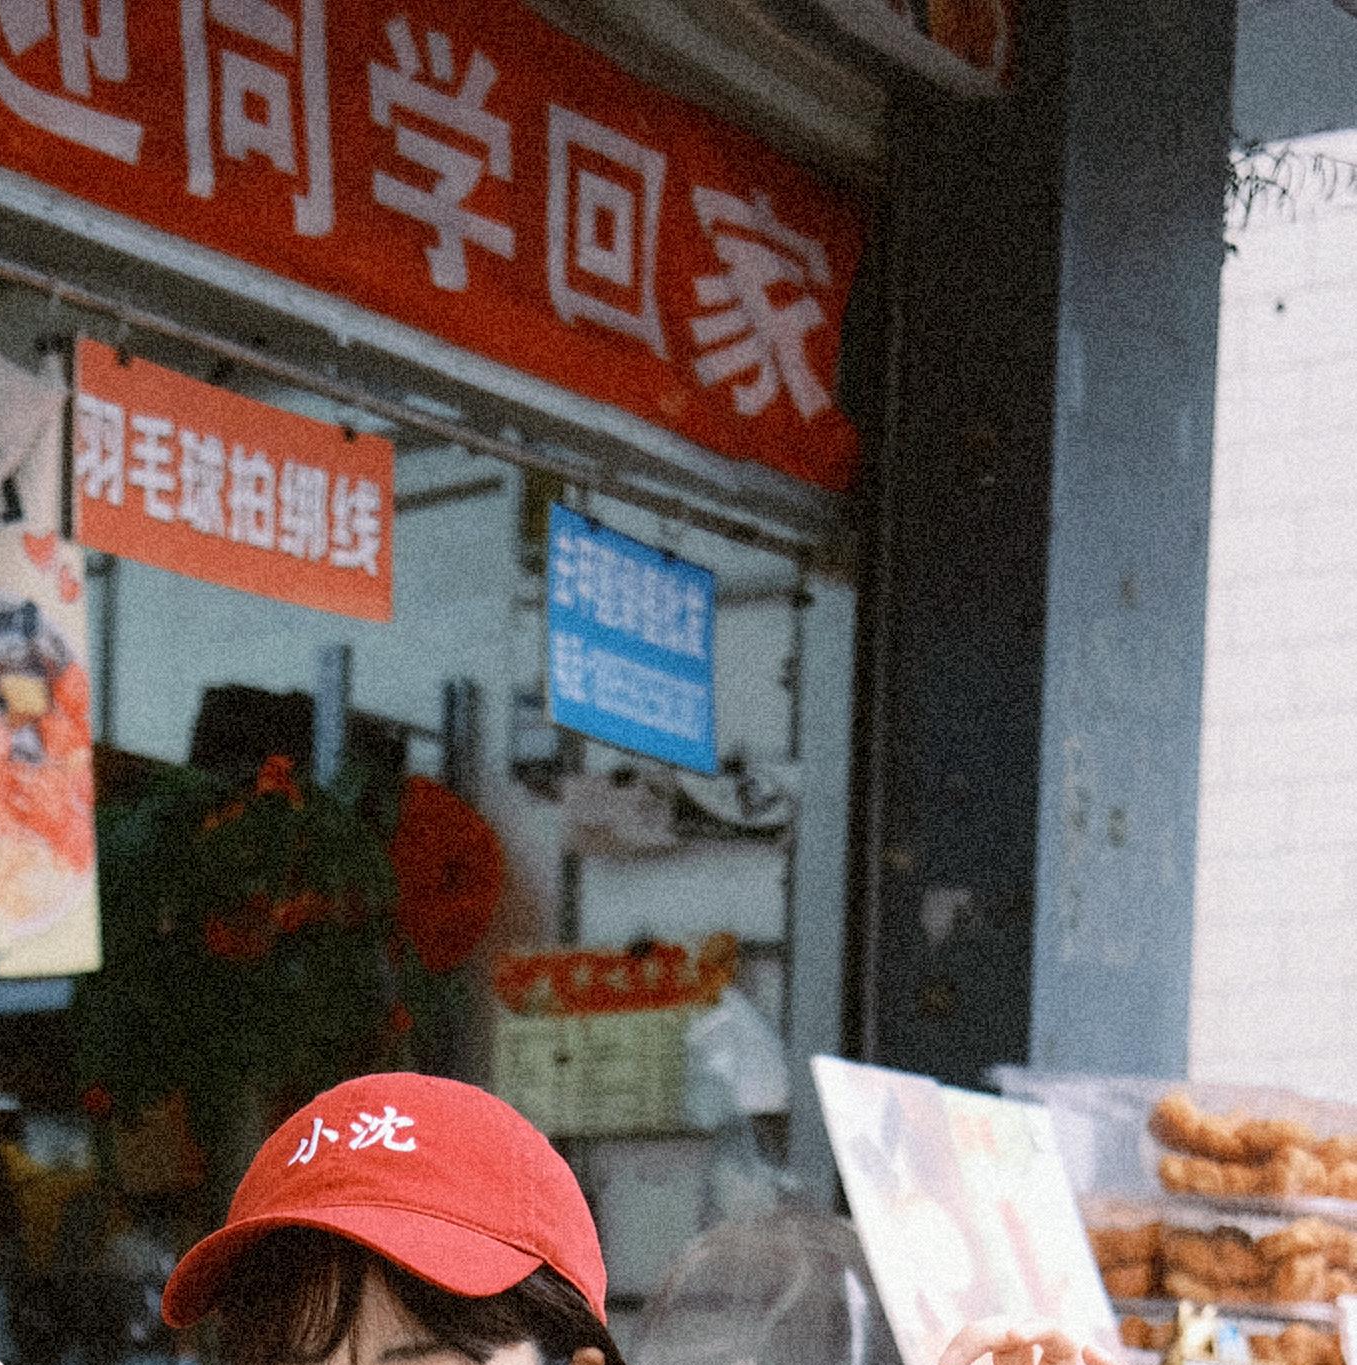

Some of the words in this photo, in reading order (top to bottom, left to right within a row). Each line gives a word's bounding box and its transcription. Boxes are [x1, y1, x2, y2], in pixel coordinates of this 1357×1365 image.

[76, 393, 381, 577] 羽毛球拍绑线
[287, 1105, 417, 1167] 小沈
